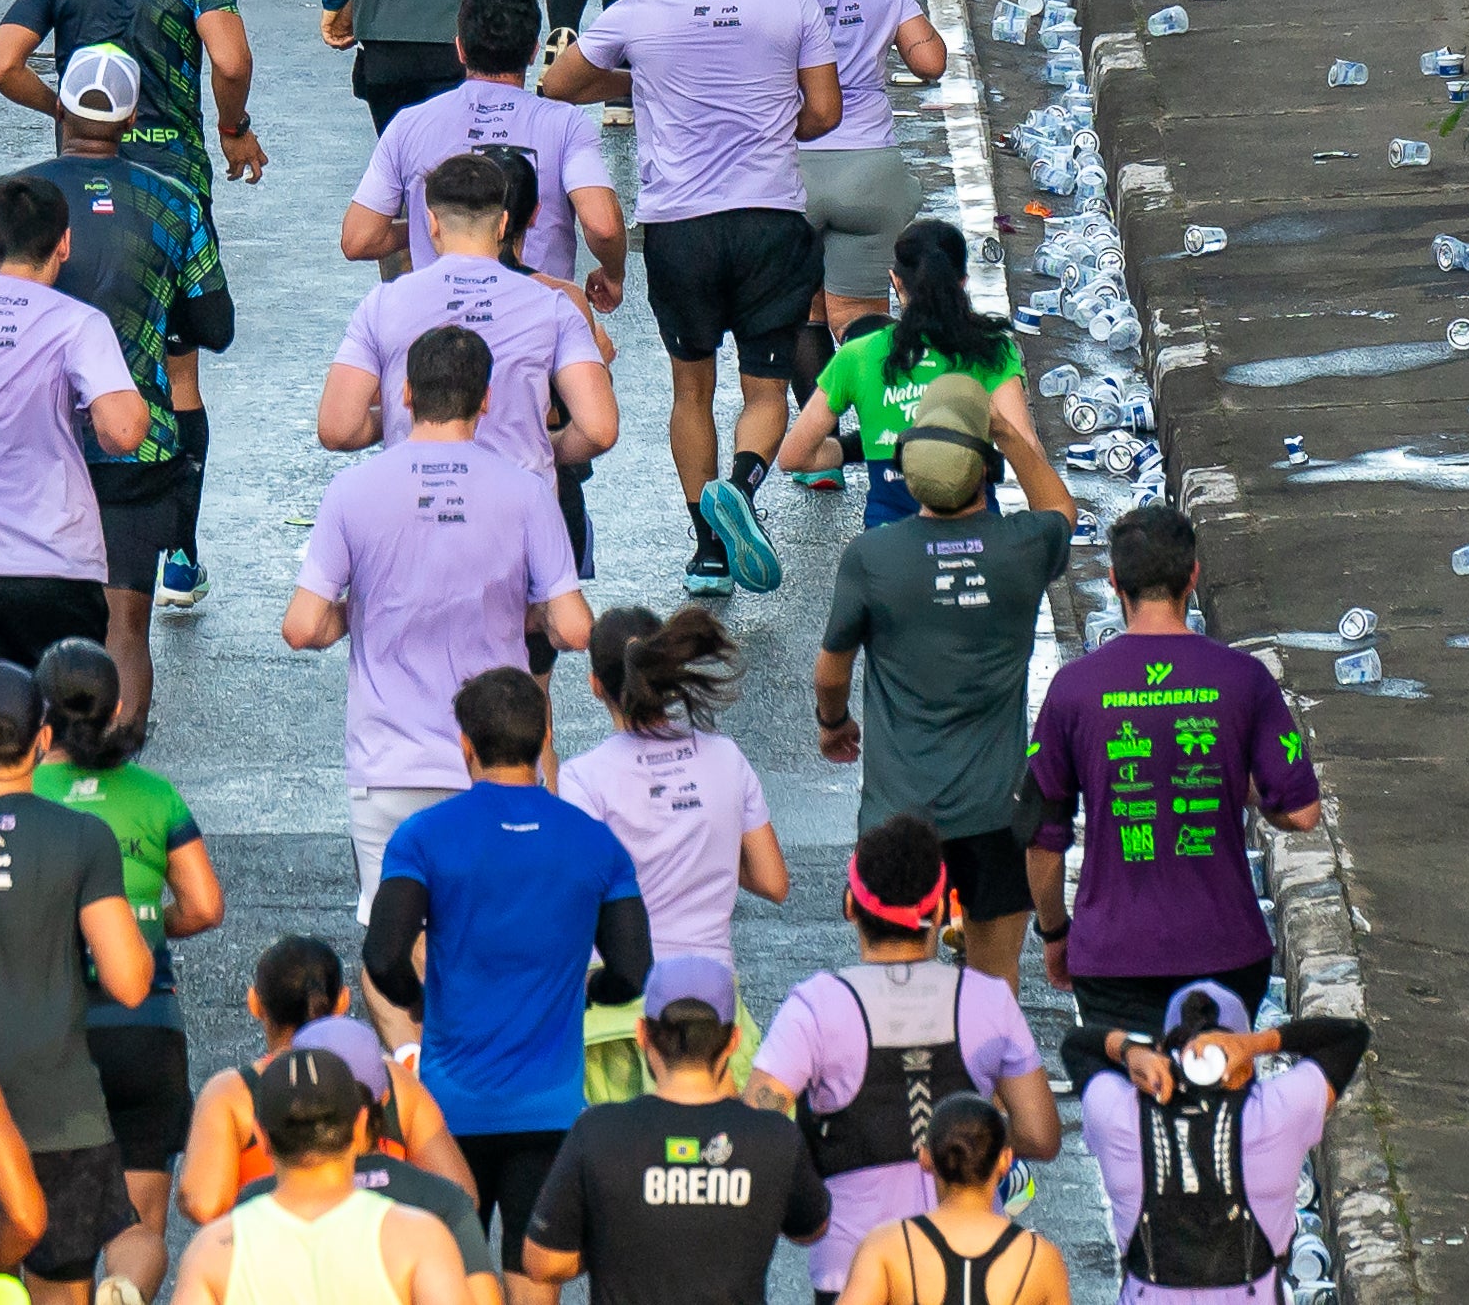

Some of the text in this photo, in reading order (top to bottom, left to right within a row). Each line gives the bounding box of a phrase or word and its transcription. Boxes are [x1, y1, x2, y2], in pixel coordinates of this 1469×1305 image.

[720, 5, 740, 15] rvb
[498, 102, 515, 112] 25
[12, 297, 30, 308] 25
[0, 324, 19, 334] rvb
[451, 463, 469, 475] 25
[1102, 688, 1220, 709] PIRACICABA/SP
[676, 747, 694, 762] 25
[643, 1166, 753, 1206] BRENO
